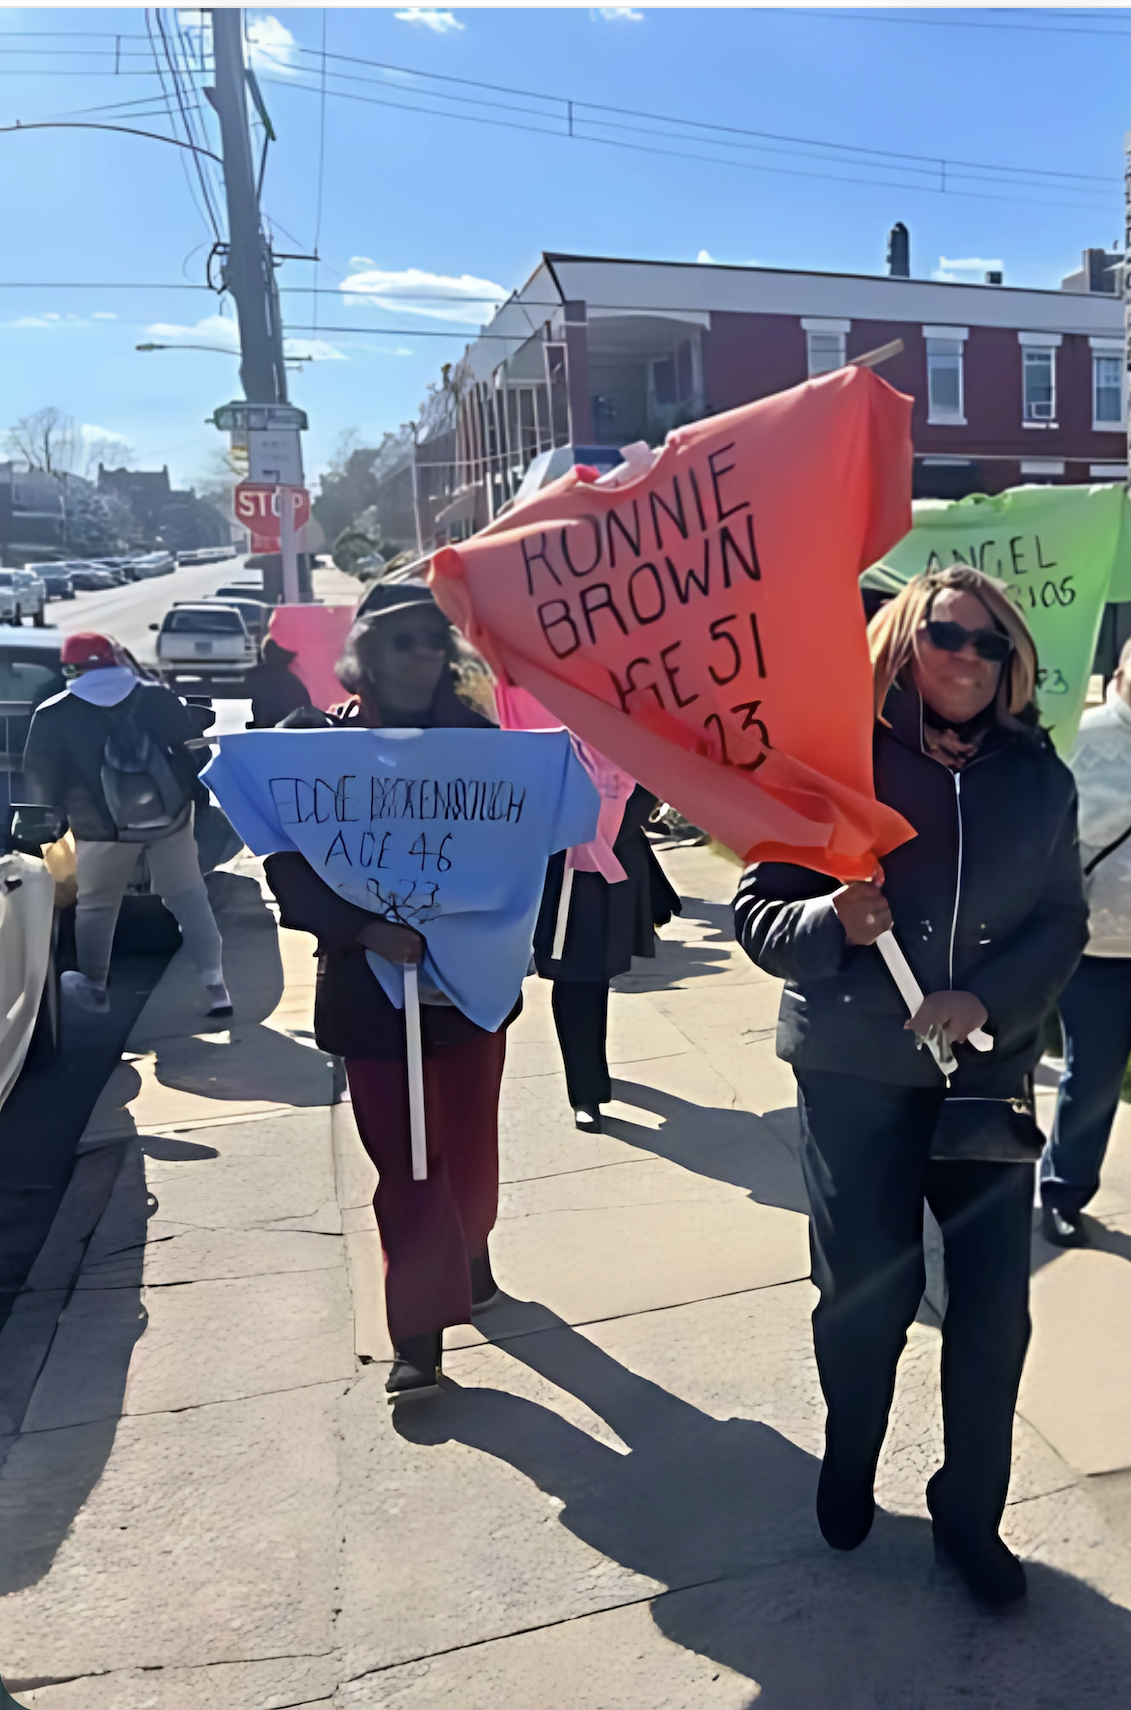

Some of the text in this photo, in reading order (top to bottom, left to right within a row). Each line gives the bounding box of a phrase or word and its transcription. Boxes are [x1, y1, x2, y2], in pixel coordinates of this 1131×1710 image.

[520, 441, 751, 596] RONNIE
[537, 514, 762, 660] BROWN
[708, 612, 767, 687] 51
[407, 831, 453, 873] 46
